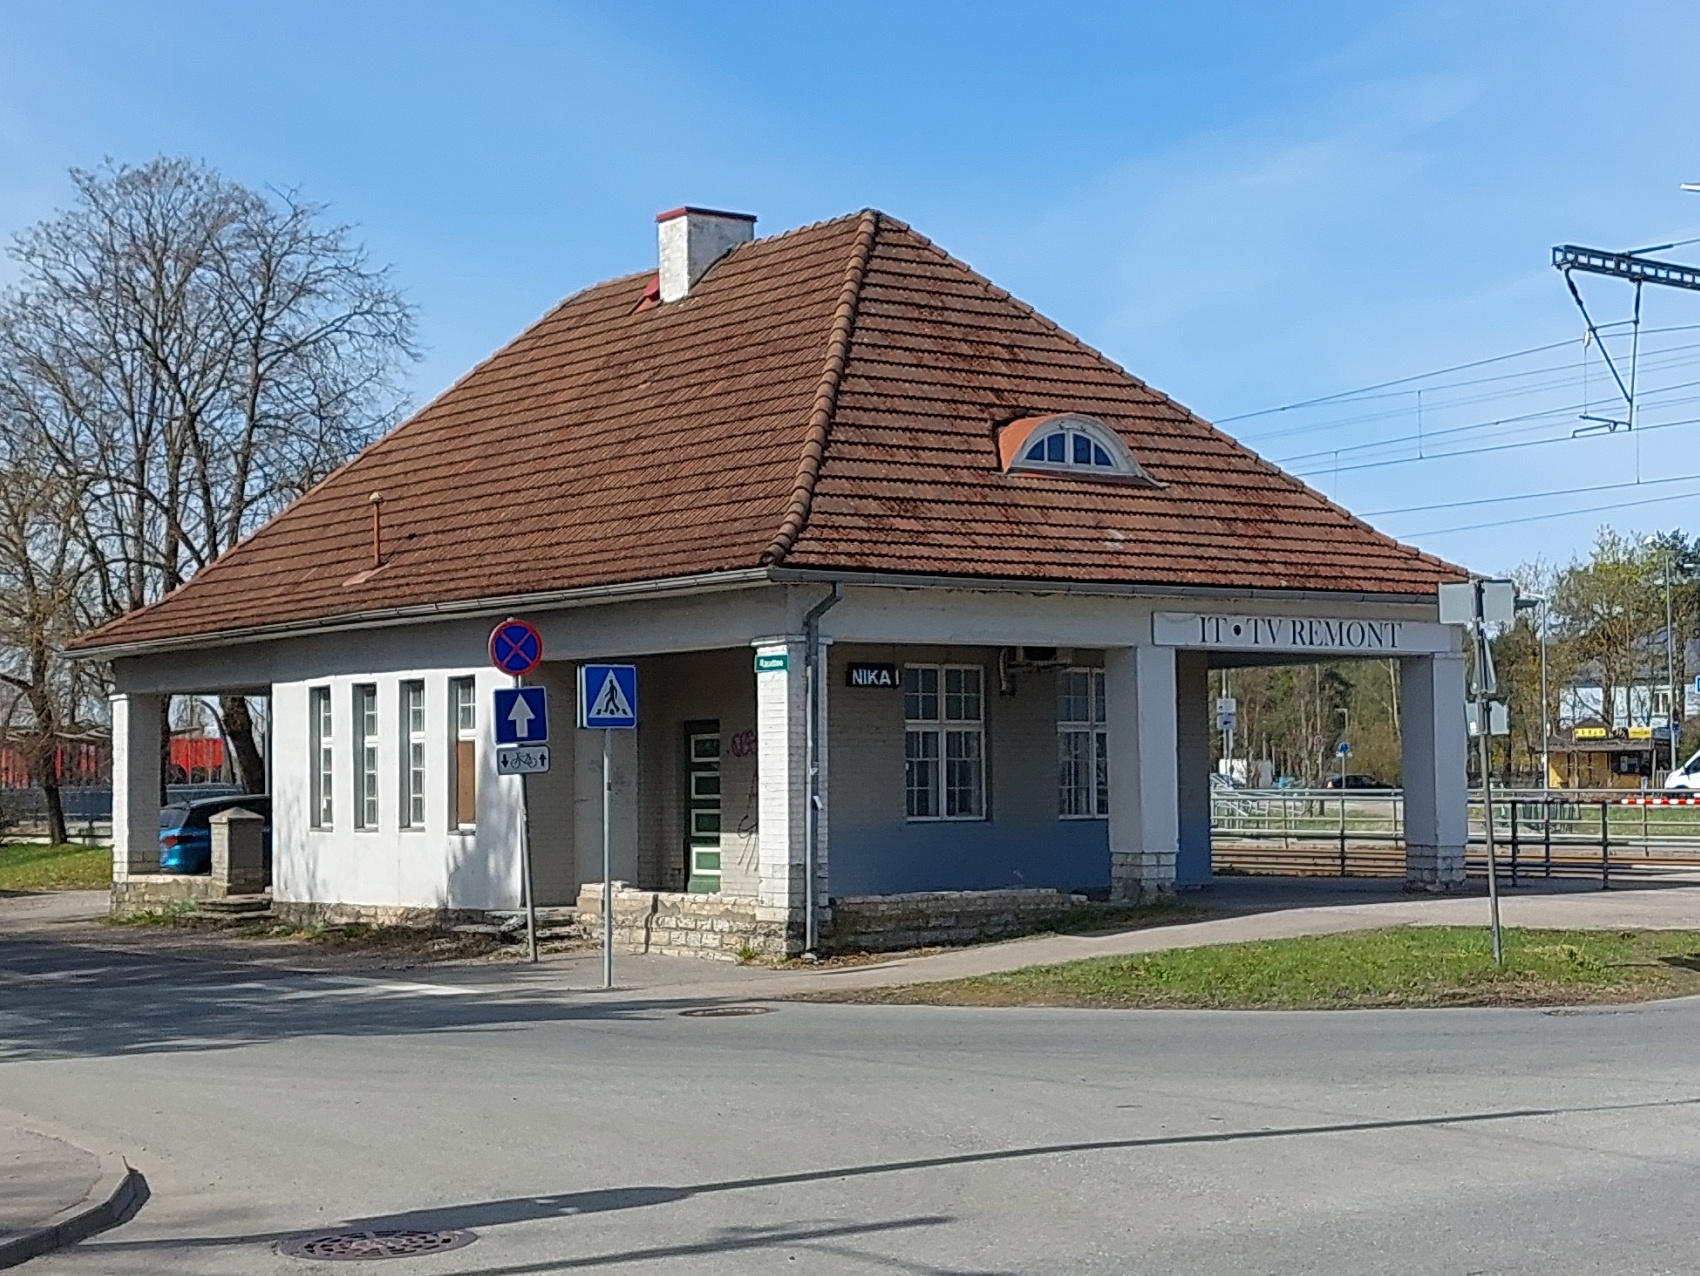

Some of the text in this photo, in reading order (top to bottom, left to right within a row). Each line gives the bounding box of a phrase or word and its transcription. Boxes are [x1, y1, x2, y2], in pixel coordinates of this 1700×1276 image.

[1246, 618, 1283, 645] TV
[1290, 619, 1403, 648] REMONT
[852, 668, 892, 686] NIKA
